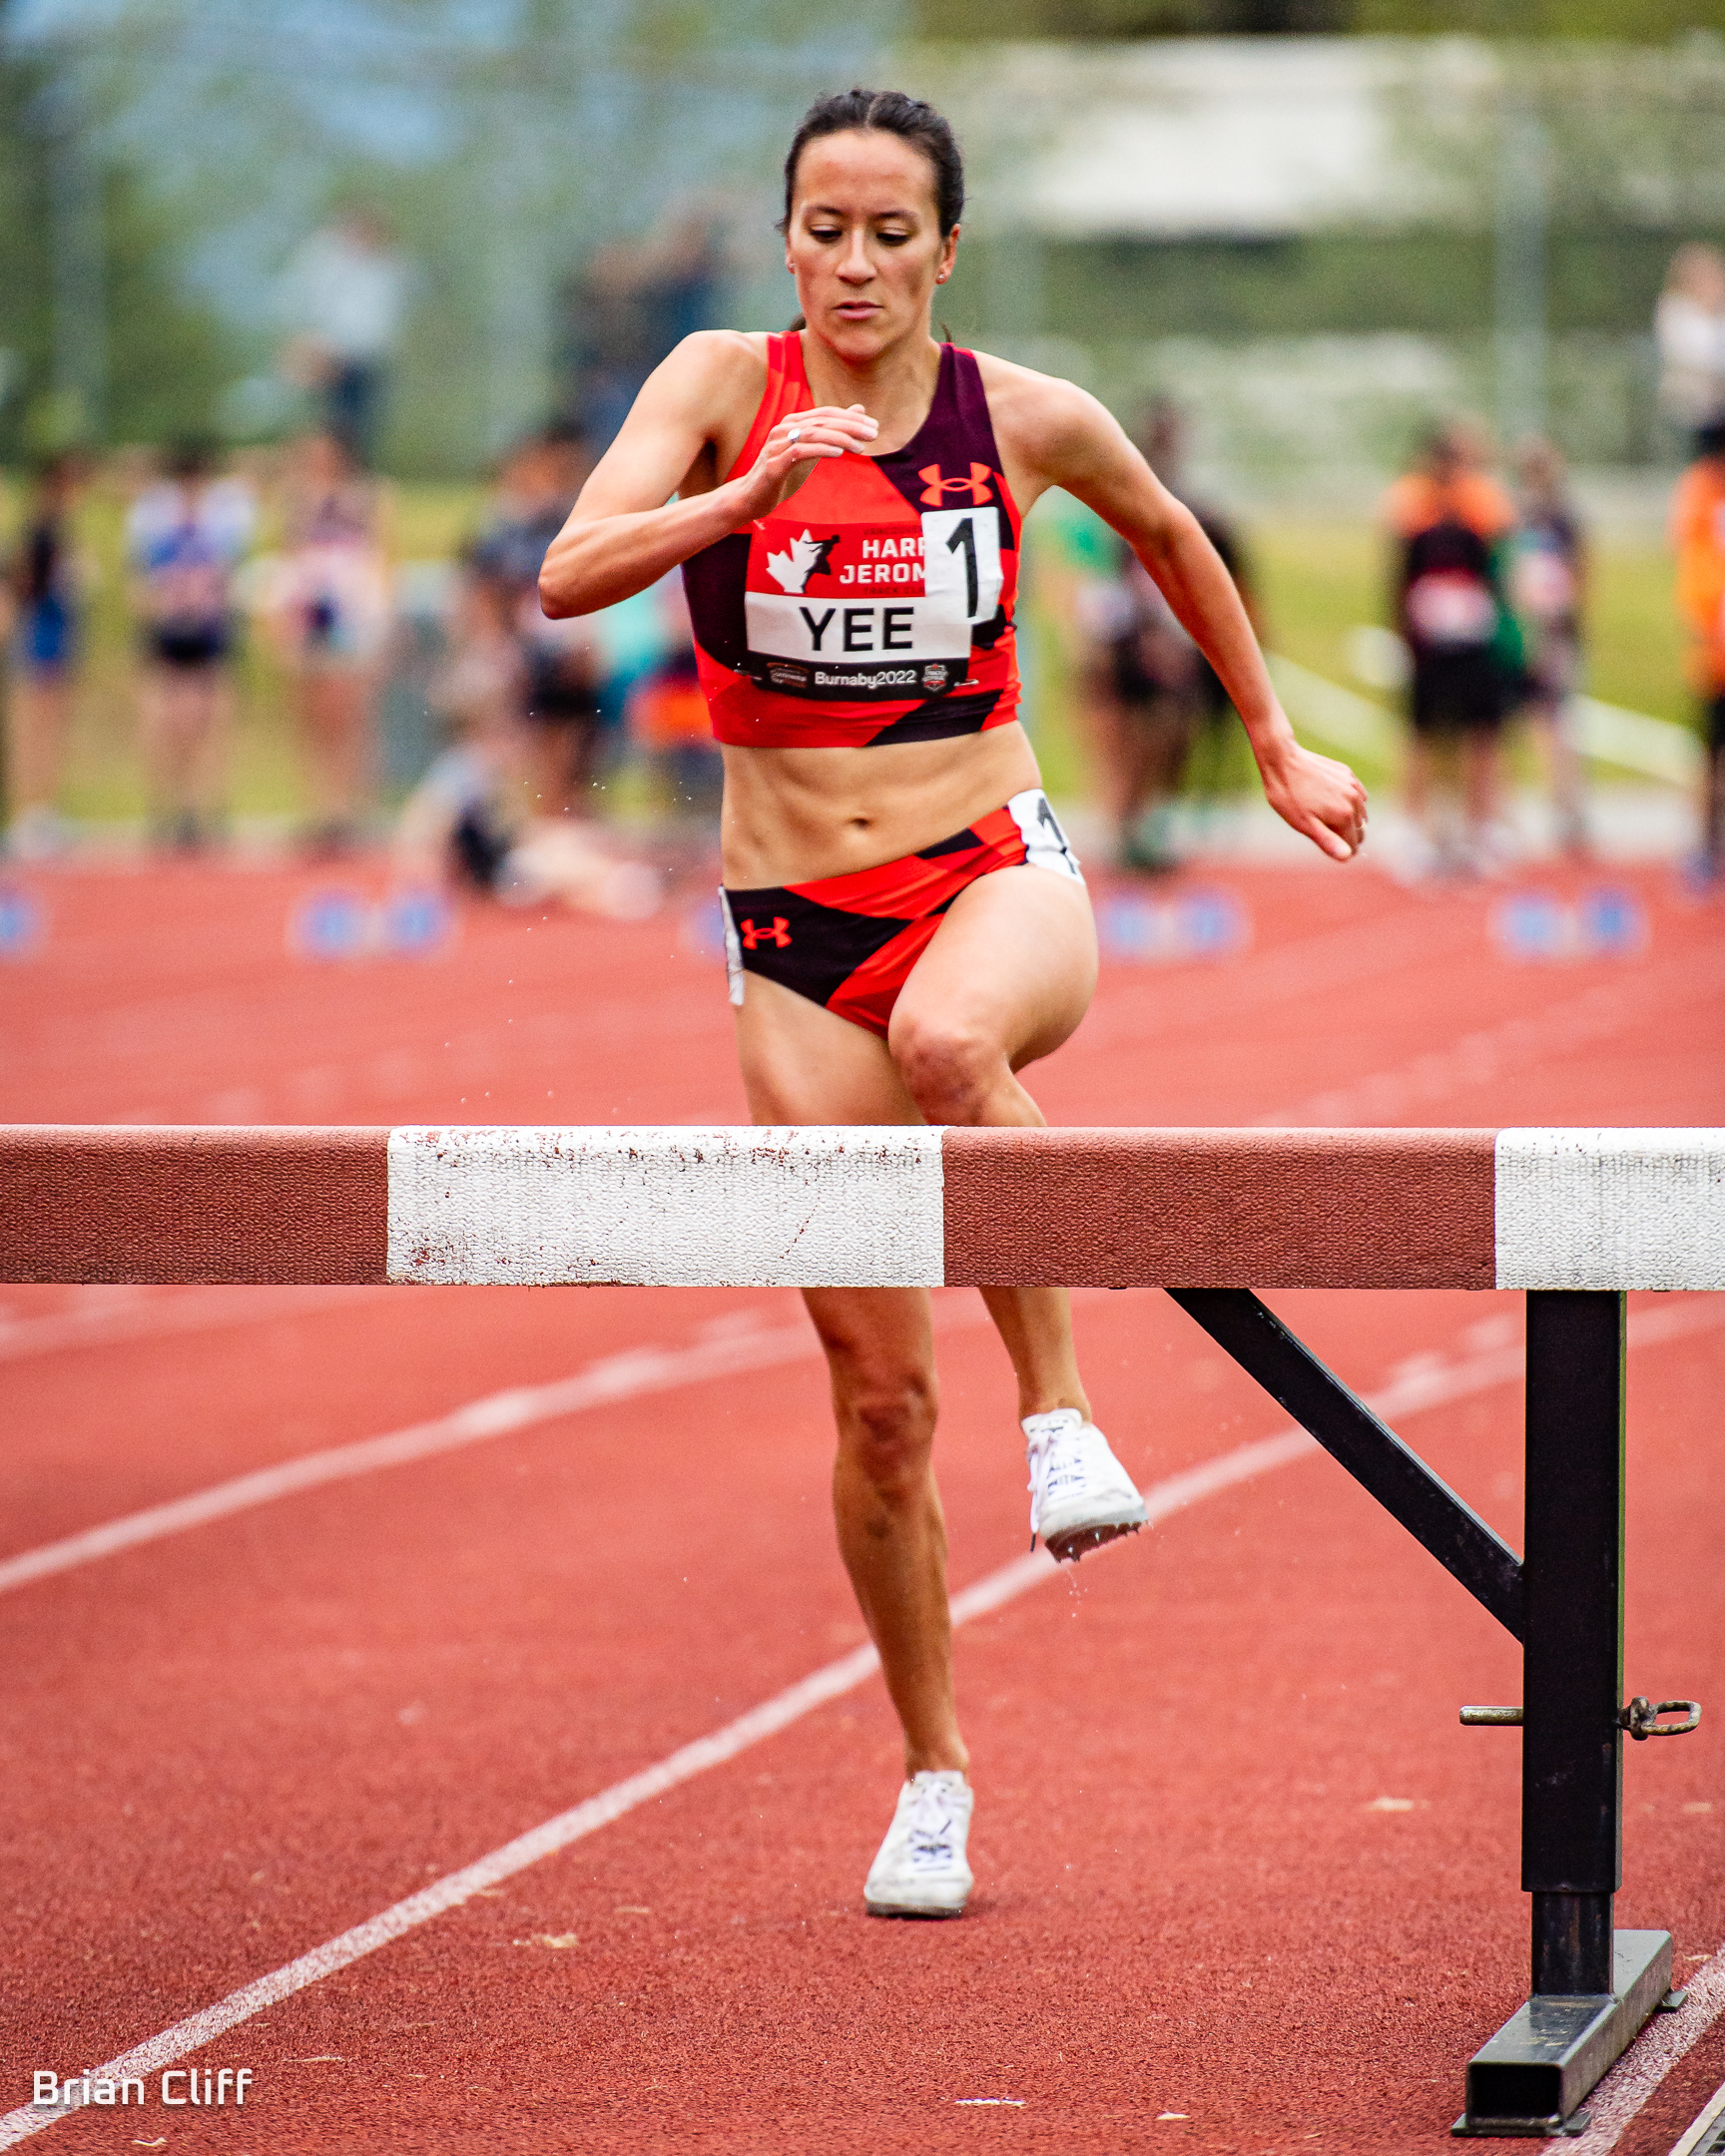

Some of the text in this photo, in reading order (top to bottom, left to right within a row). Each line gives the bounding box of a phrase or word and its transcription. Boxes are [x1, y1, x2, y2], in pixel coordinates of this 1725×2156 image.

[840, 562, 926, 584] JEROM
[945, 517, 979, 619] 1
[799, 606, 915, 653] YEE
[814, 669, 917, 691] Burnaby2022
